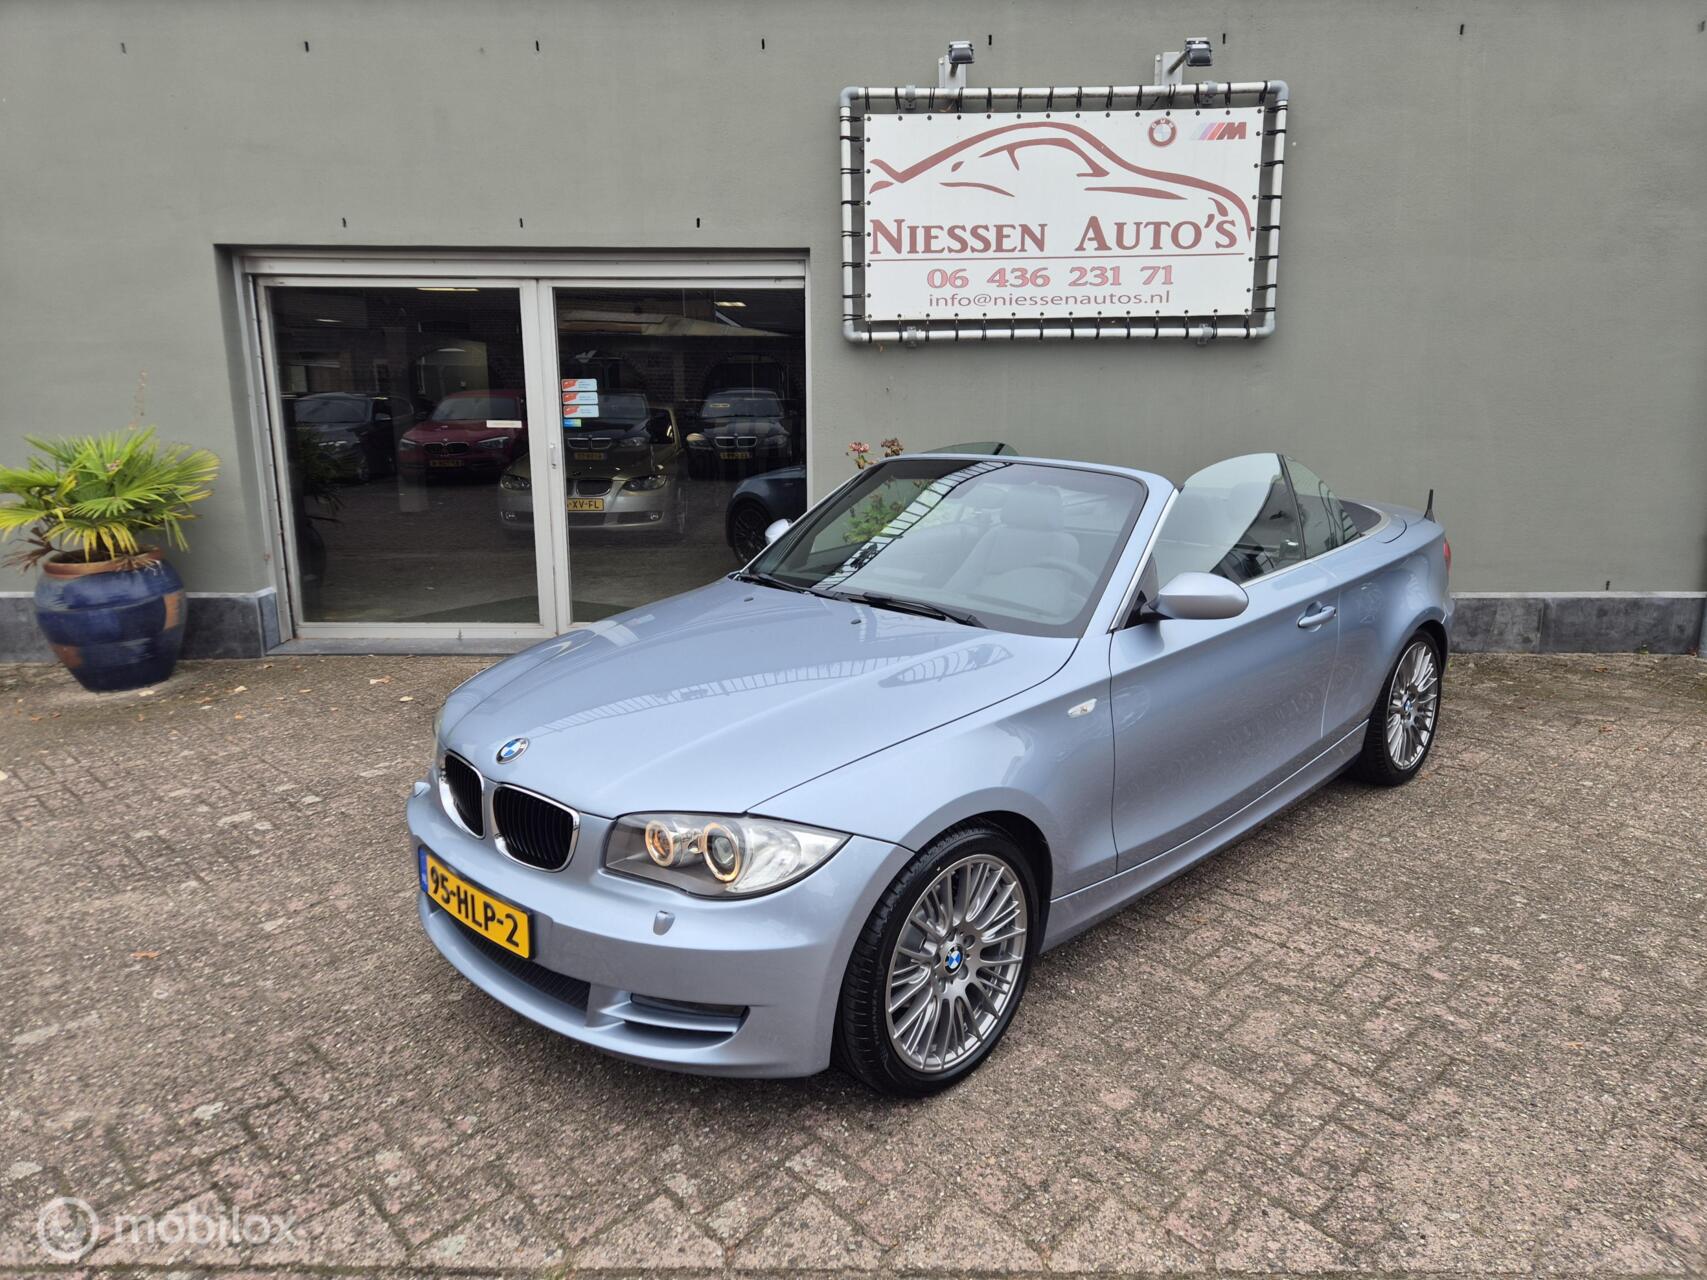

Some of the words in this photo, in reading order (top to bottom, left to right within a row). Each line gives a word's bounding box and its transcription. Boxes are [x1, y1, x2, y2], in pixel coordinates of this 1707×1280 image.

[1216, 121, 1247, 140] M
[870, 218, 1047, 254] NIESSEN
[1075, 214, 1238, 251] AUTO'S
[927, 268, 969, 288] 06
[986, 267, 1051, 288] 436
[1068, 265, 1122, 287] 231
[1139, 264, 1174, 286] 71
[929, 290, 1170, 307] info@niessenautos.nl
[430, 865, 520, 948] 95-HLP-2
